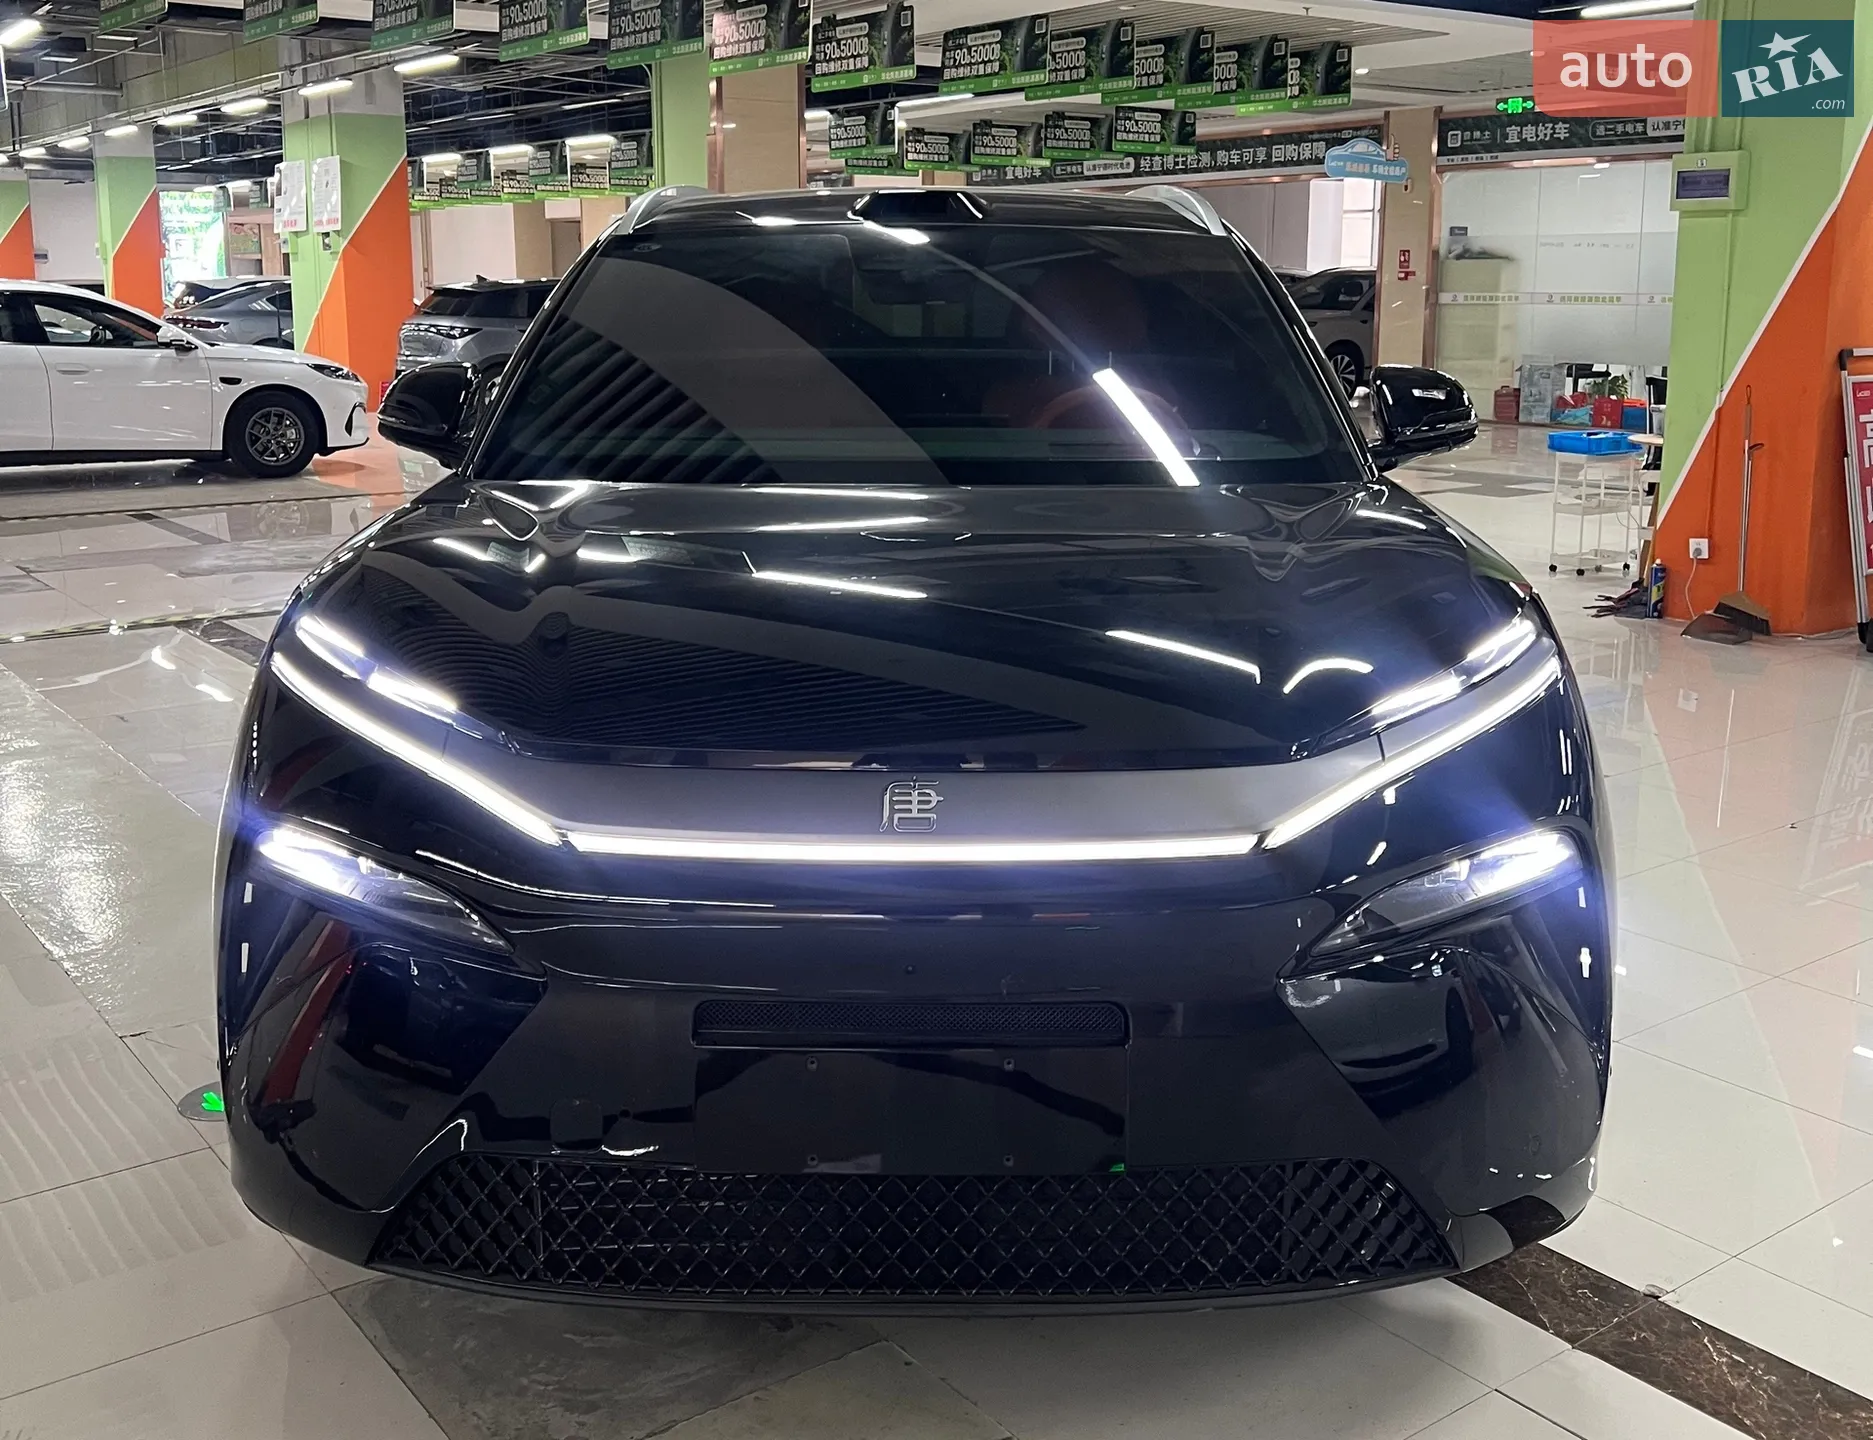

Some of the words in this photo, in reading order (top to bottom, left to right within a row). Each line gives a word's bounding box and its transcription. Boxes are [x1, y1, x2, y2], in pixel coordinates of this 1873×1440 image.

[1505, 121, 1570, 143] 宜电好车
[1596, 122, 1645, 136] 选二手电车
[1272, 141, 1326, 162] 回购保障
